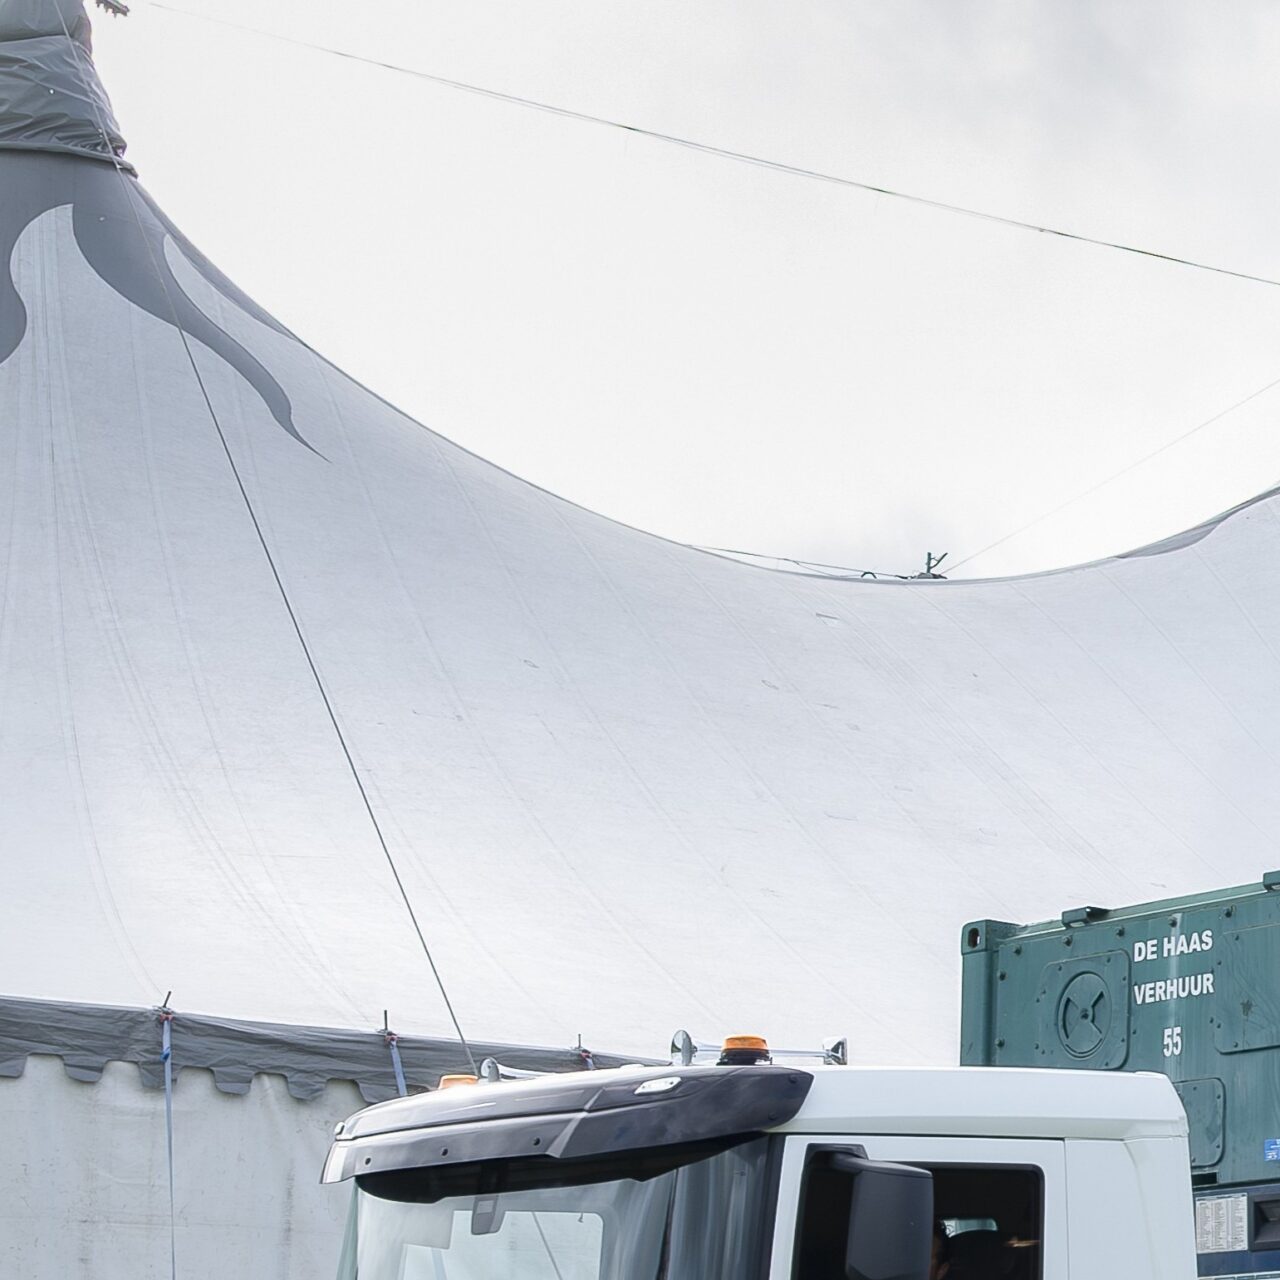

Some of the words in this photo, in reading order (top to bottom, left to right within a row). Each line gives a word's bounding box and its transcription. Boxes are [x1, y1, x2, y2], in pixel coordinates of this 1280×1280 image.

[1134, 939, 1158, 962] DE
[1163, 930, 1213, 957] HAAS
[1134, 973, 1214, 1005] VERHUUR
[1163, 1026, 1182, 1057] 55
